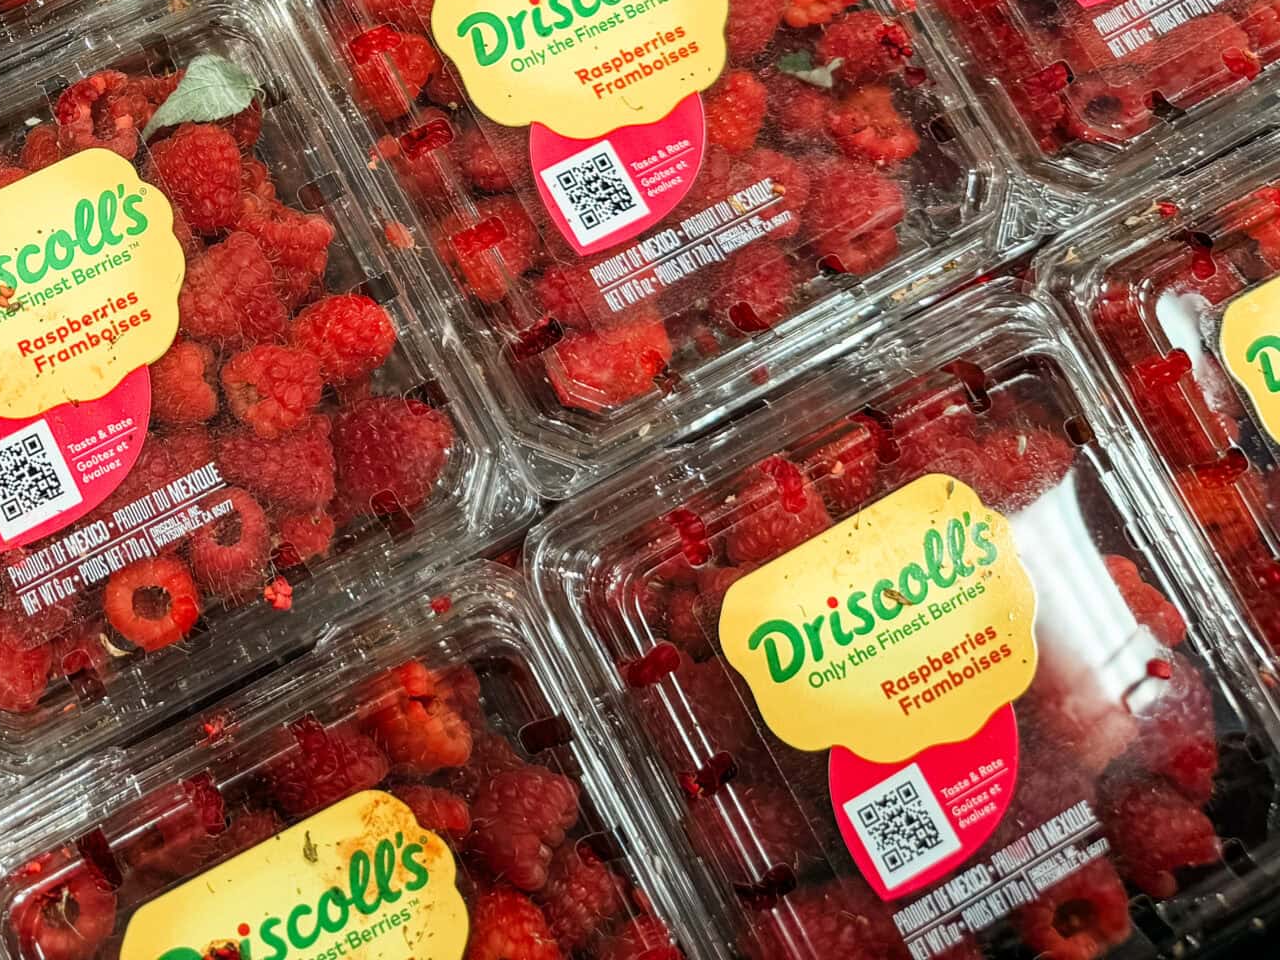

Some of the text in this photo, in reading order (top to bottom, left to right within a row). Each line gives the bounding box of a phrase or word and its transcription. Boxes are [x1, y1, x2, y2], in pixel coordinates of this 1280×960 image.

[510, 48, 544, 74] Only
[546, 37, 575, 56] the
[574, 11, 624, 43] Finest
[576, 25, 686, 85] Raspberries
[593, 41, 699, 100] Framboises
[17, 291, 139, 358] Raspberries
[18, 277, 73, 312] Finest
[34, 308, 152, 374] Framboises
[66, 418, 134, 455] Taste & Rate
[117, 441, 129, 453] et
[7, 461, 223, 589] PRODUCT OF MEXICO PRODUIT DU MEXIQUE
[20, 589, 43, 617] NET
[37, 581, 59, 607] WT
[61, 576, 77, 596] oz
[77, 554, 111, 586] POIDS
[104, 545, 127, 573] NET
[808, 658, 845, 690] Only
[847, 645, 878, 668] the
[876, 612, 930, 651] Finest
[881, 625, 996, 699] Raspberries
[899, 643, 1011, 716] Framboises
[158, 831, 429, 960] iscoll's
[892, 800, 1096, 937] PRODUCT OF MEXICO PRODUIT DU MEXIQUE
